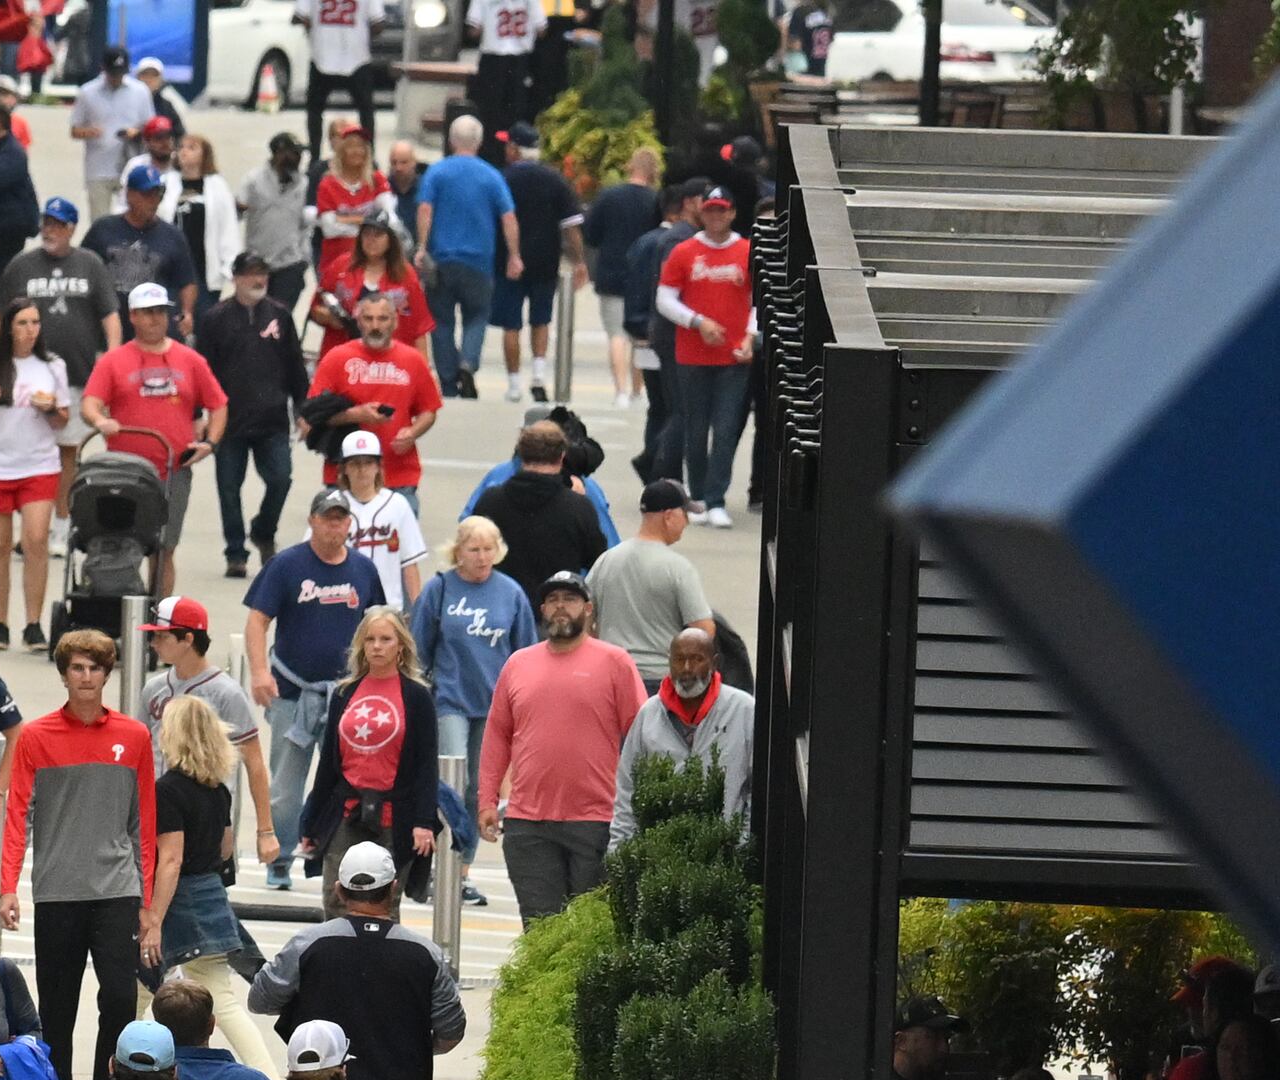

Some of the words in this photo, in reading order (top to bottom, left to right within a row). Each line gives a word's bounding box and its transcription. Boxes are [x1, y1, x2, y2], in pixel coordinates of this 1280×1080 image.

[497, 9, 528, 37] 22
[26, 277, 89, 294] BRAVES
[297, 579, 353, 604] Braves
[447, 597, 489, 624] chop
[466, 615, 507, 648] chop
[111, 743, 125, 762] P
